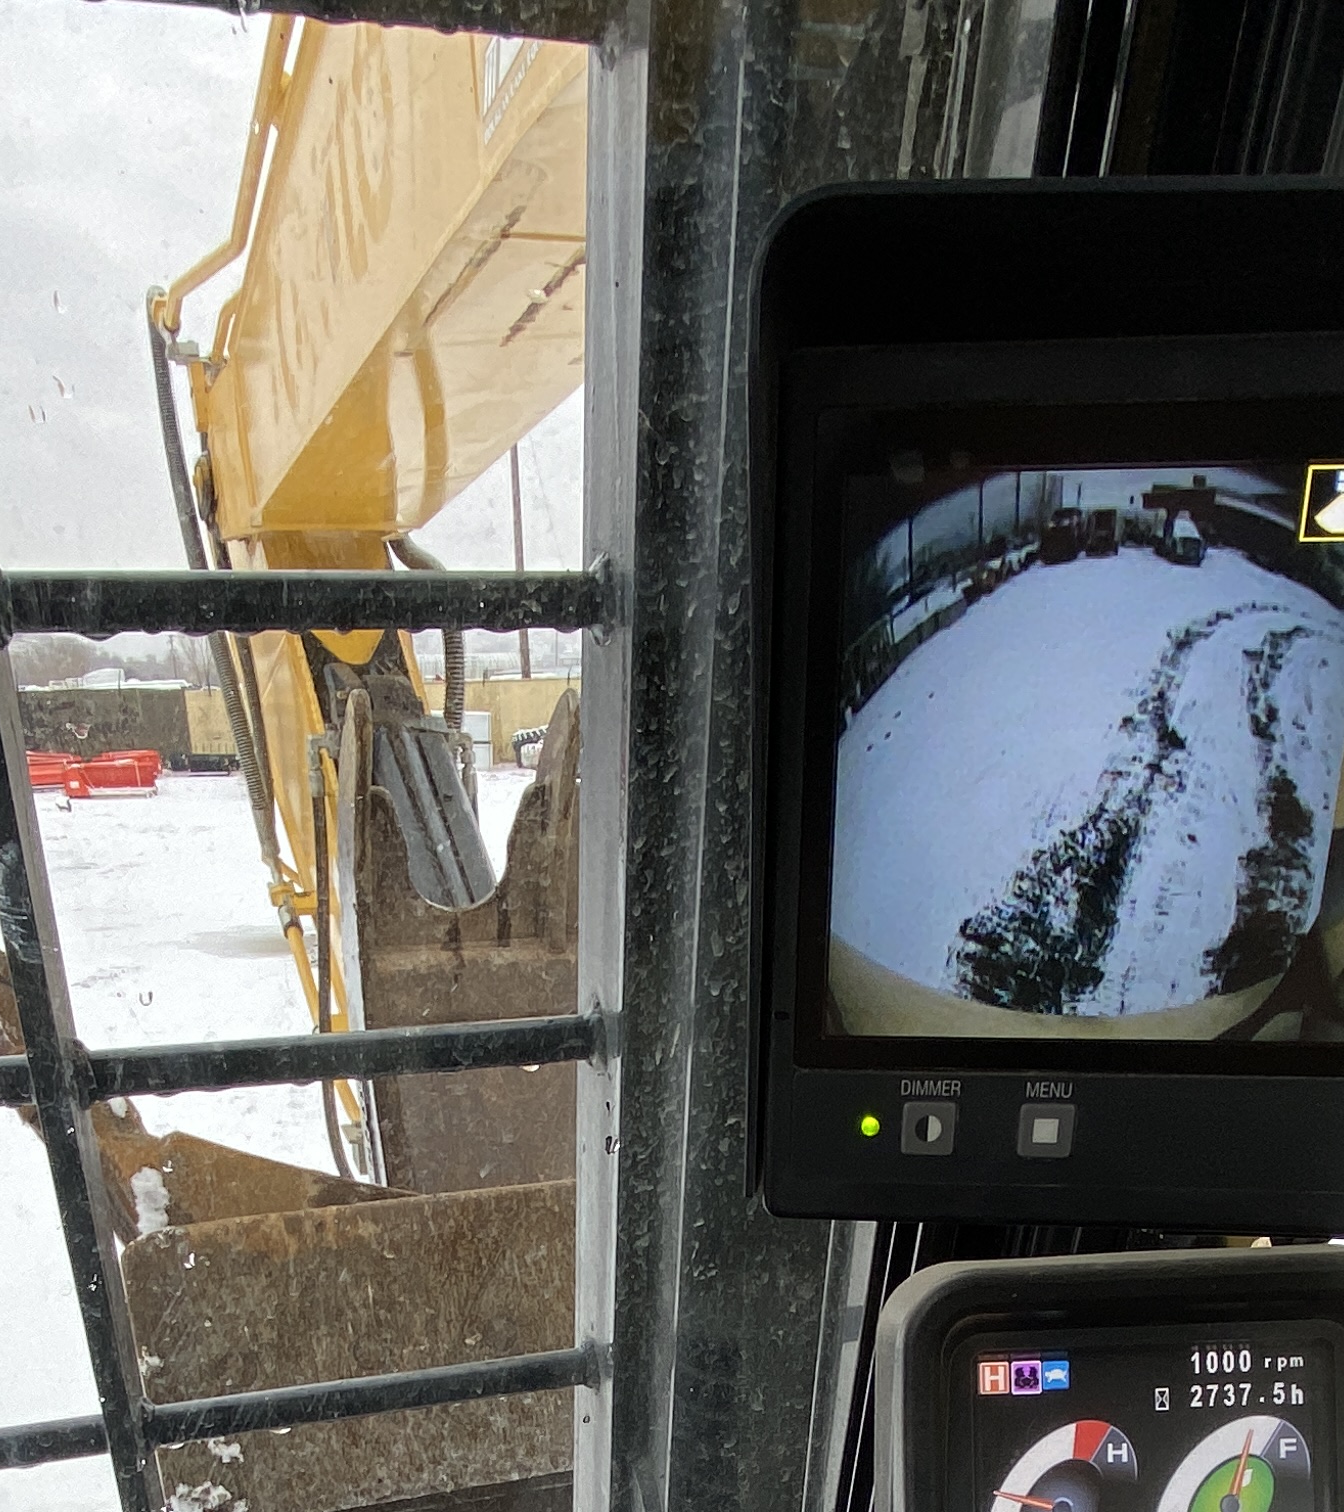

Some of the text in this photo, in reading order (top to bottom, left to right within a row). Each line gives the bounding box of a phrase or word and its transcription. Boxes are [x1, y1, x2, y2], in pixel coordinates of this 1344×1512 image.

[901, 1080, 961, 1097] DIMMER
[1026, 1081, 1074, 1099] MENU
[1190, 1350, 1303, 1374] 1000 rpm
[984, 1366, 1006, 1391] H
[1107, 1443, 1129, 1463] H
[1279, 1439, 1297, 1458] F
